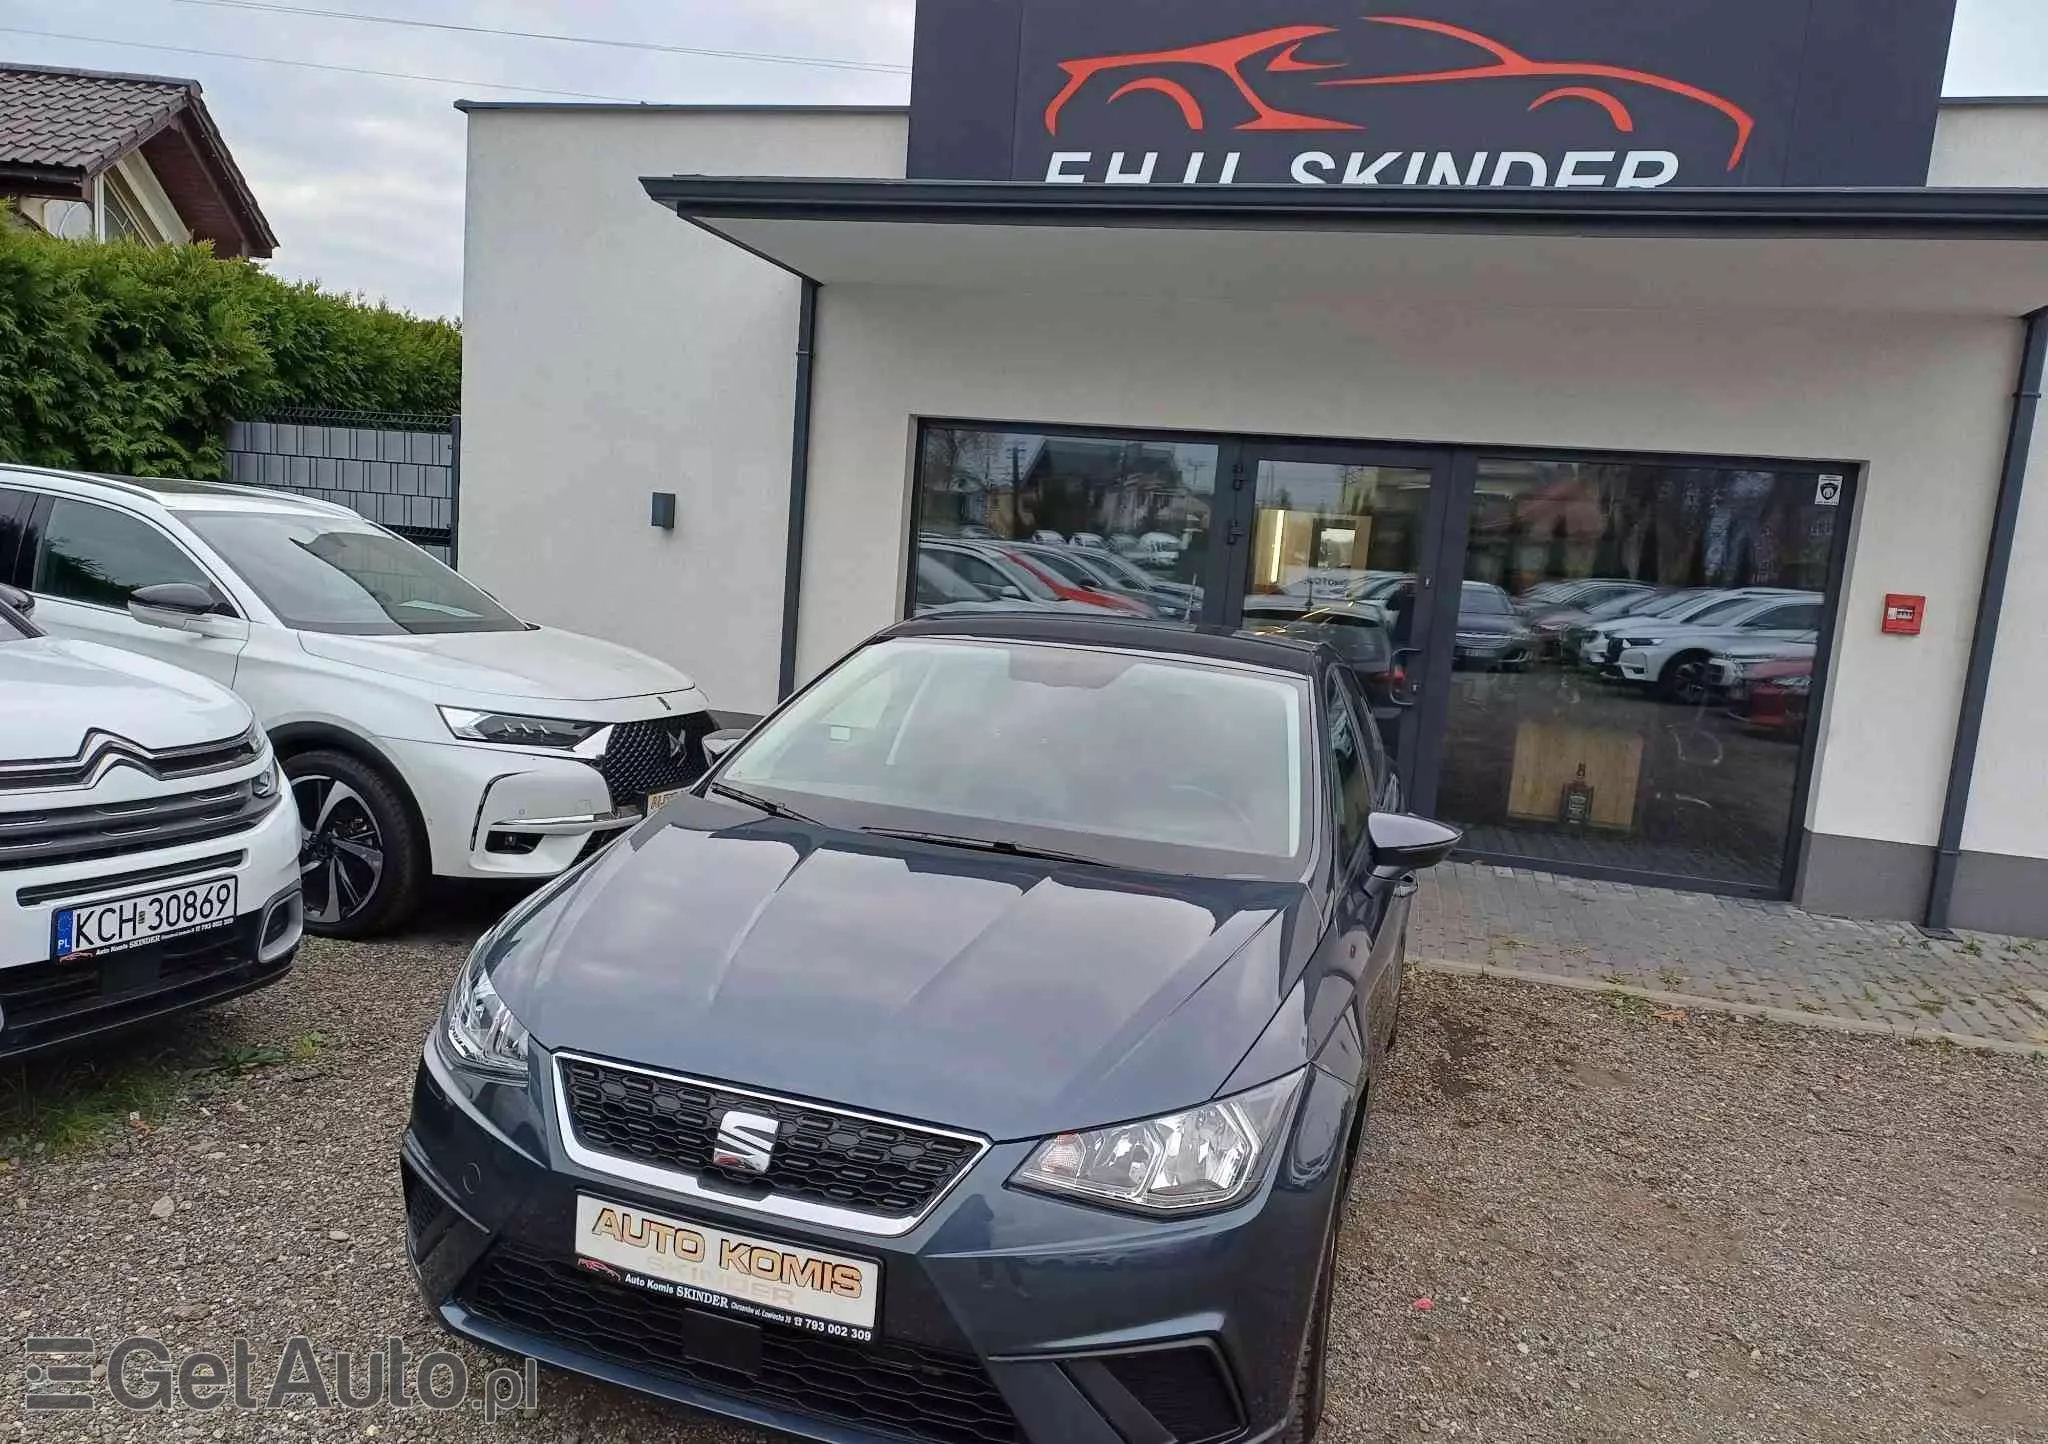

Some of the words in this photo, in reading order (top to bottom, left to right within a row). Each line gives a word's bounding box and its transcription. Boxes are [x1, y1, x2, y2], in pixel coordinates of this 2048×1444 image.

[1290, 150, 1680, 188] SKINDER
[75, 902, 138, 948] KCH
[148, 883, 231, 931] 30869
[57, 939, 71, 950] PL
[592, 1207, 706, 1264] AUTO
[719, 1238, 863, 1299] KOMIS
[646, 1256, 795, 1305] SKINDER
[625, 1273, 645, 1287] Auto
[646, 1279, 674, 1294] Komis
[676, 1285, 729, 1309] SKINDER
[805, 1318, 825, 1332] 793
[827, 1324, 848, 1337] 002
[851, 1328, 872, 1341] 309
